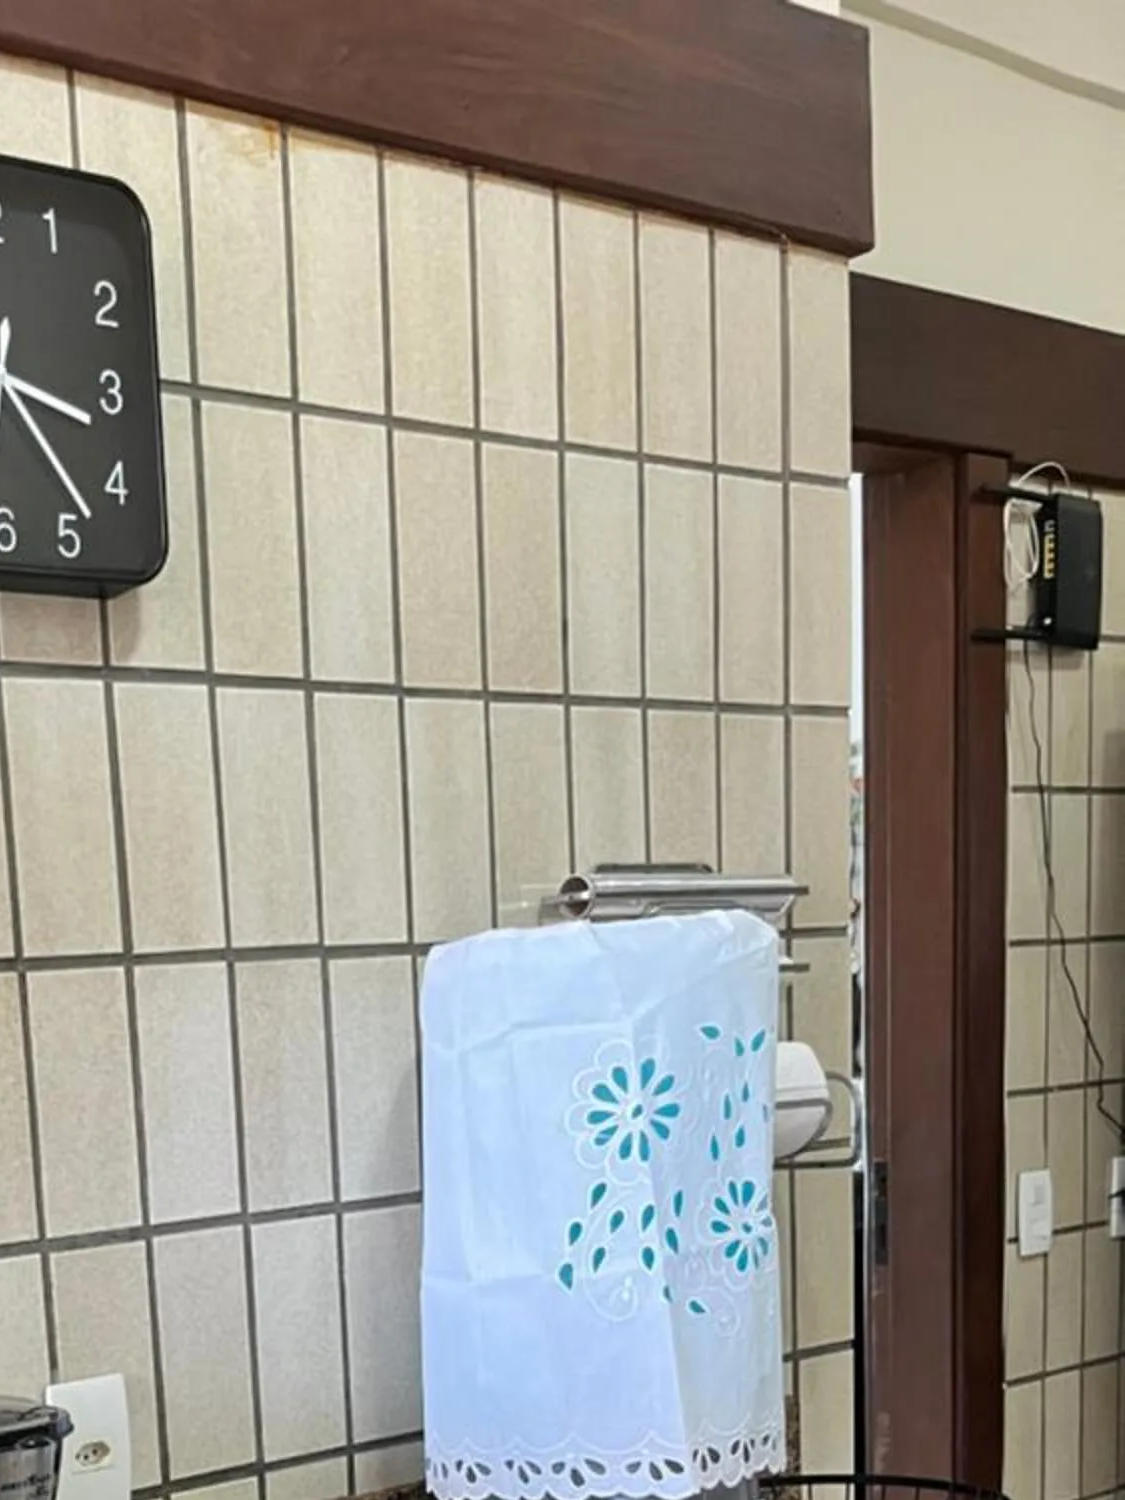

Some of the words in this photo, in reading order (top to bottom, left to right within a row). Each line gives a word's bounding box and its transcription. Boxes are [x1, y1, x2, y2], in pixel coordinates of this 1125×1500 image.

[42, 208, 58, 254] 1
[93, 280, 119, 328] 2
[99, 369, 124, 415] 3
[104, 461, 129, 505] 4
[57, 514, 82, 558] 5
